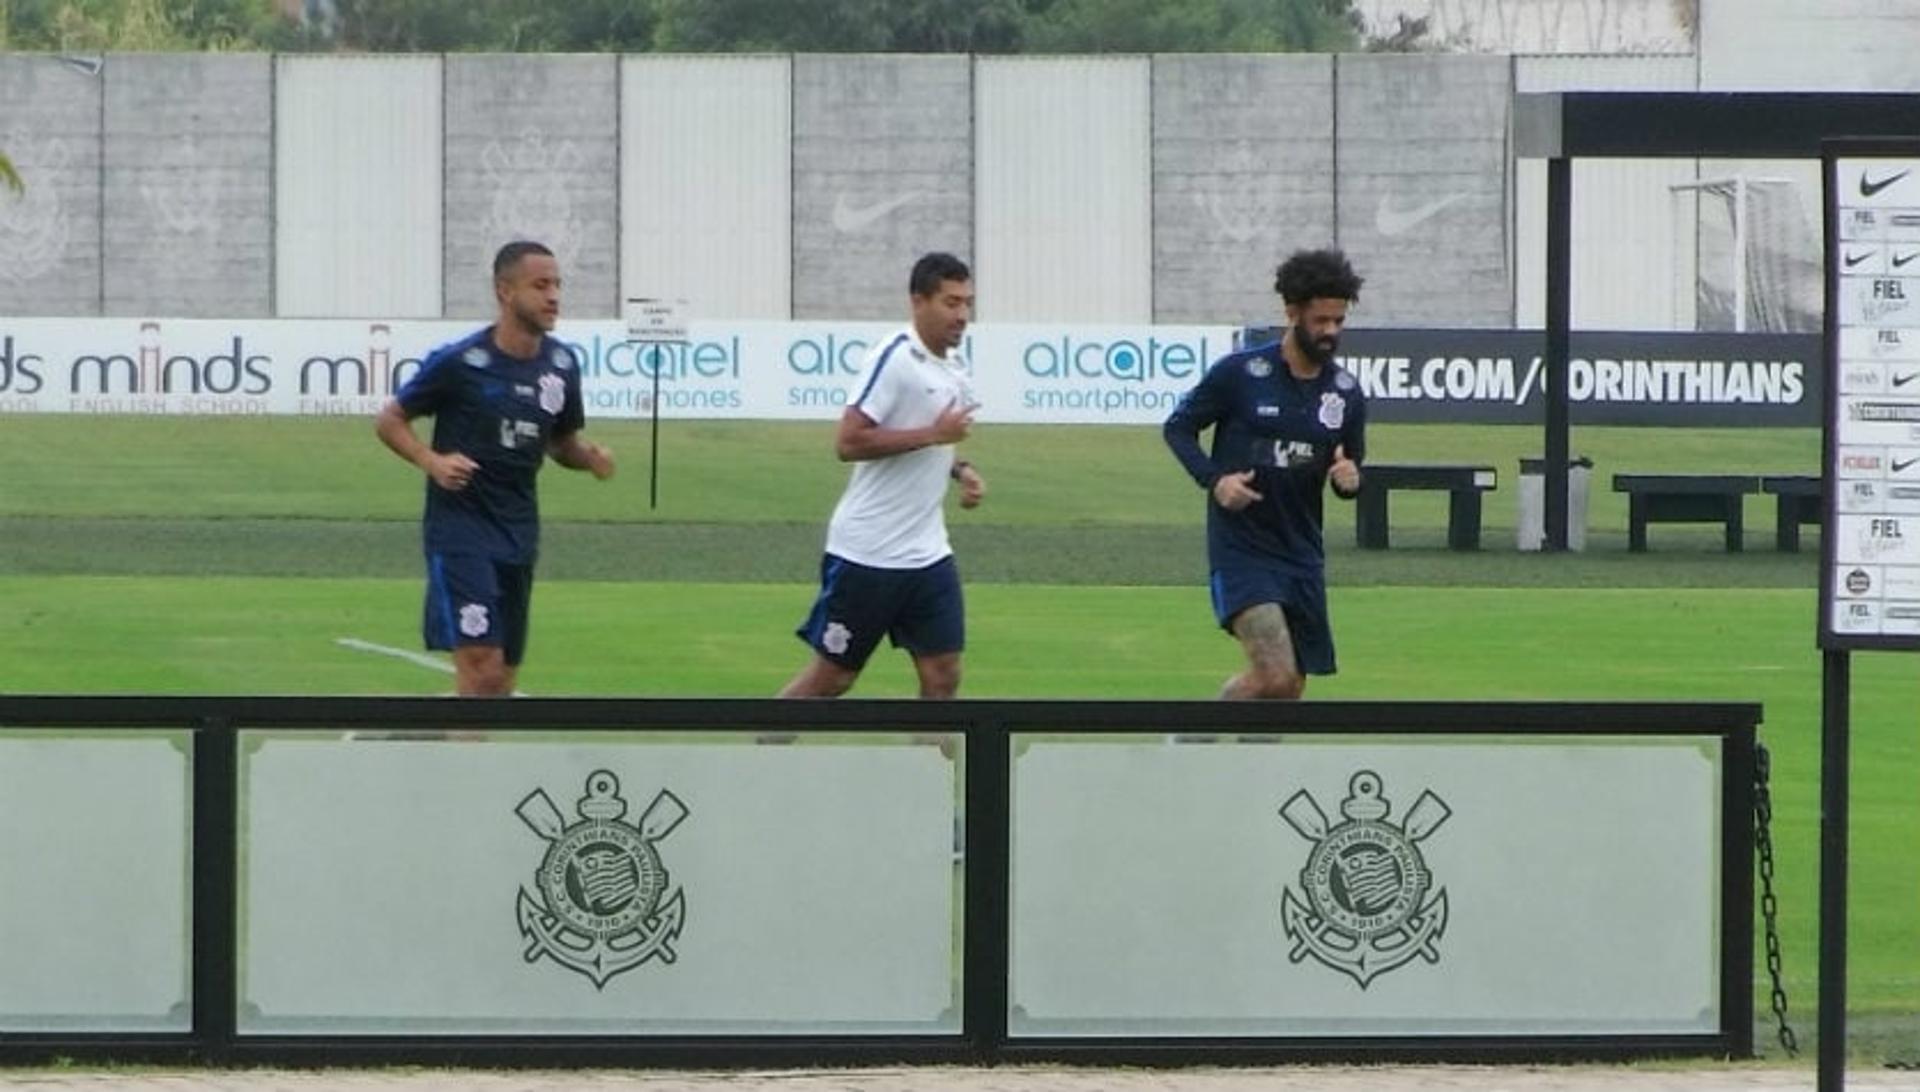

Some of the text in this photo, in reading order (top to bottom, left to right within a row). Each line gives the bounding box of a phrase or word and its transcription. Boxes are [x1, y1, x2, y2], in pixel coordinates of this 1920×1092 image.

[1874, 280, 1905, 299] FIEL
[70, 322, 271, 394] minds
[1024, 336, 1207, 382] alcatel
[1871, 519, 1902, 538] FIEL
[1317, 829, 1393, 886] CORINTHIANS
